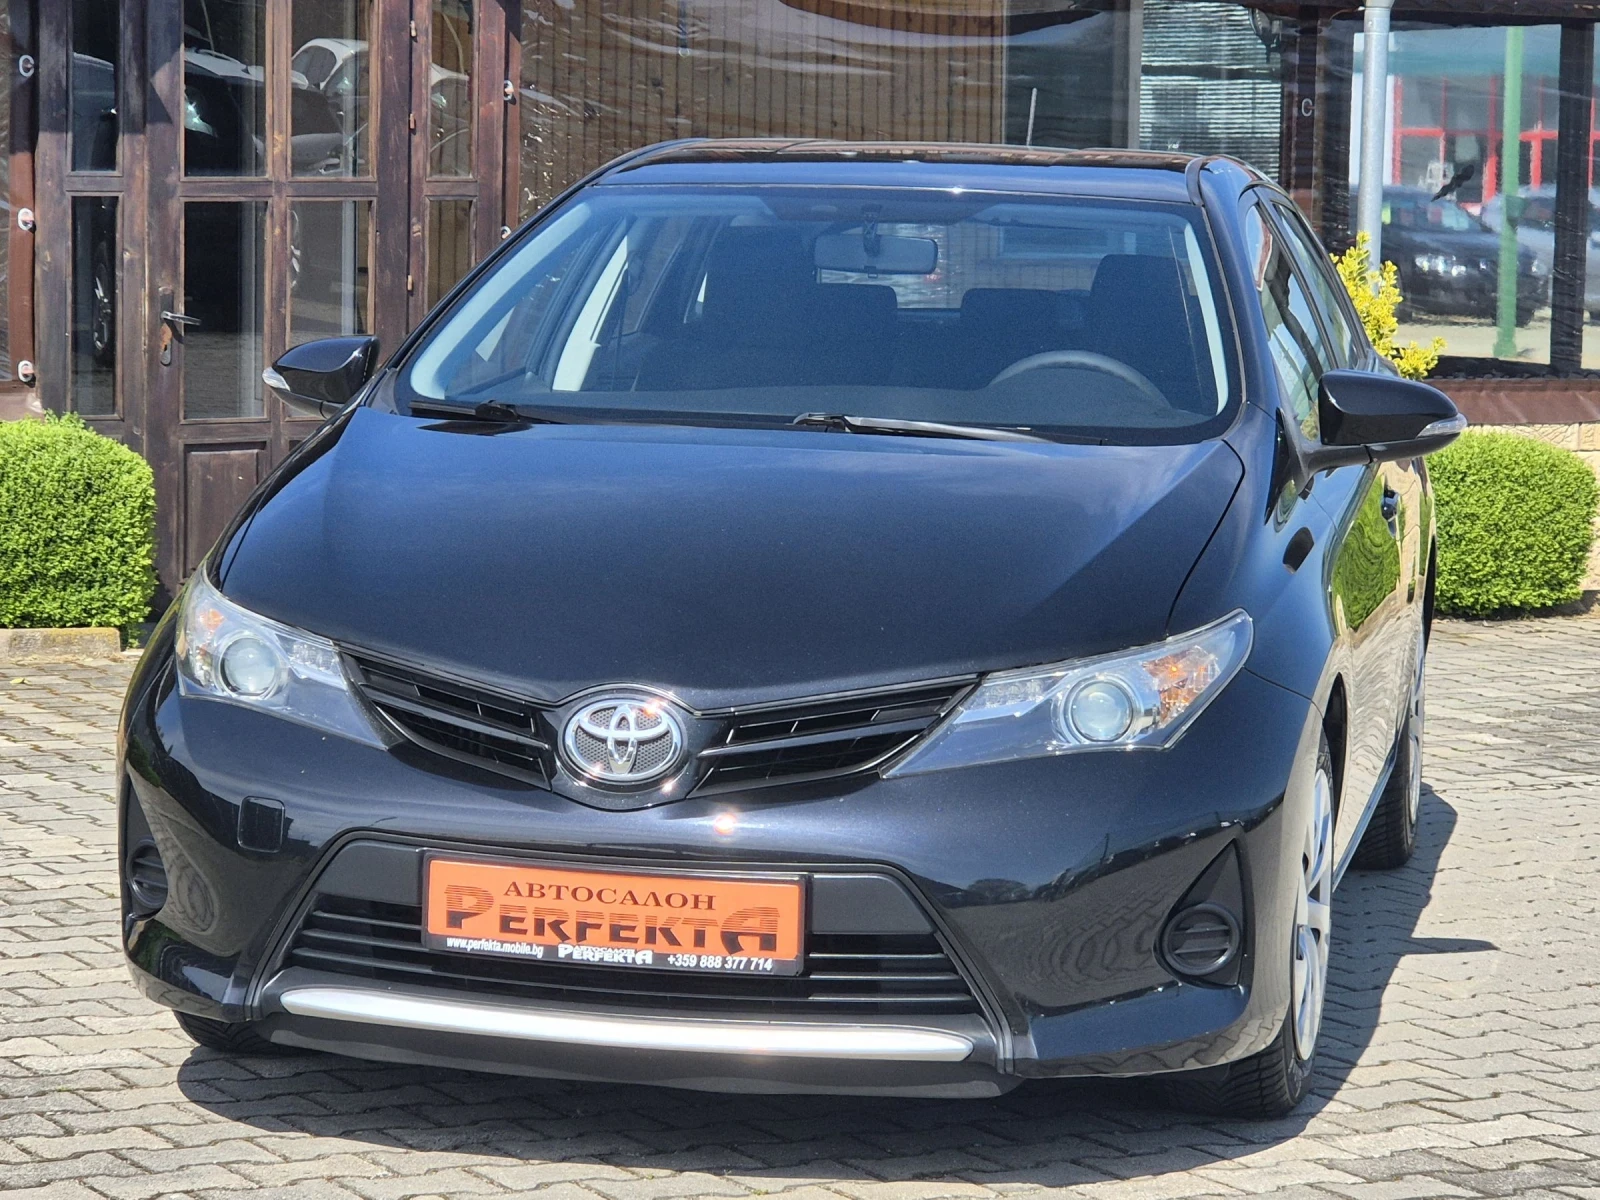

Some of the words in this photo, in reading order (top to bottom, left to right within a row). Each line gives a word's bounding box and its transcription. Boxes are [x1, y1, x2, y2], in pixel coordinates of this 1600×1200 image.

[503, 880, 717, 911] АВТОСАЛОН
[444, 884, 781, 954] PERFEKTA
[446, 937, 544, 959] www.perfekta.mobile.bg
[557, 943, 653, 965] PERFEKTA
[667, 953, 697, 968] +359
[699, 955, 722, 969] 888
[724, 956, 748, 970] 377
[750, 957, 773, 971] 714
